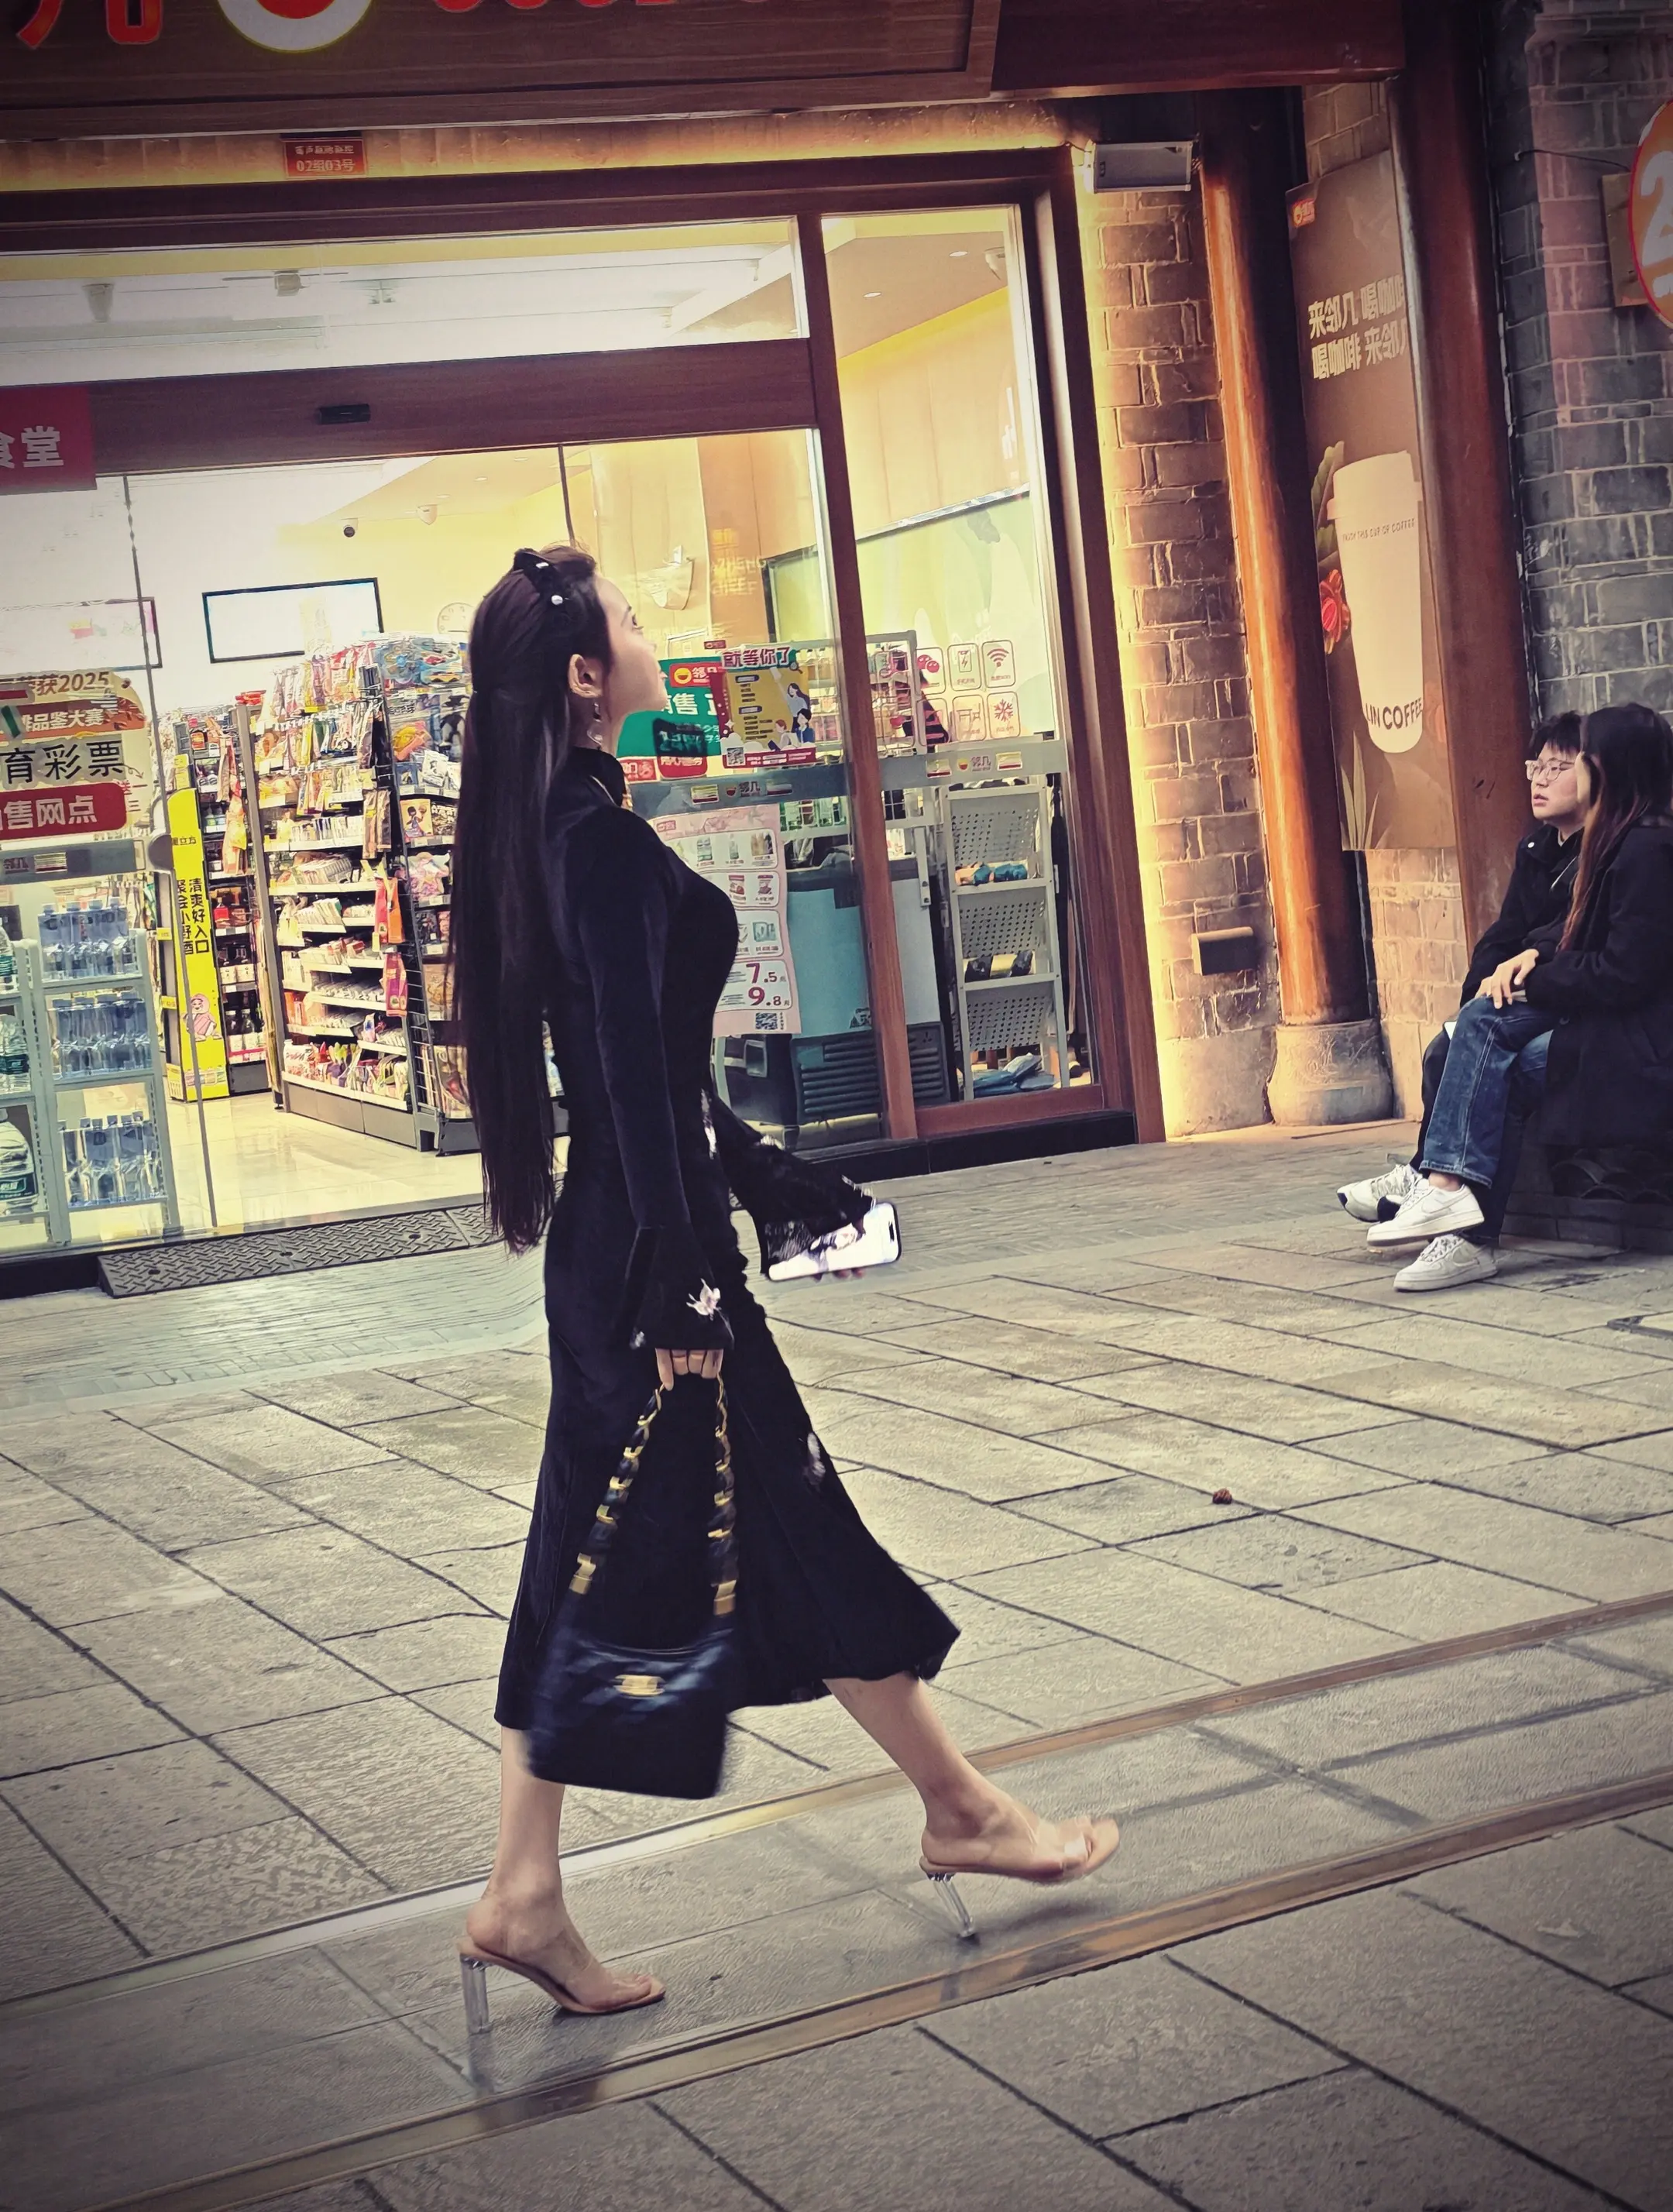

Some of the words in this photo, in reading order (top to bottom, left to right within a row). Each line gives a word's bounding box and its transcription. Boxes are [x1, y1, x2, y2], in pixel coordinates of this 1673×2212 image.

[1307, 291, 1359, 339] 来邻几
[1311, 333, 1362, 380] 喝咖啡
[722, 646, 790, 668] 就等你了
[1366, 702, 1380, 728] LIN
[1383, 697, 1423, 730] COFFEE
[0, 740, 124, 784] 育彩票
[0, 795, 98, 831] 售网点
[189, 878, 209, 953] 清爽好入口
